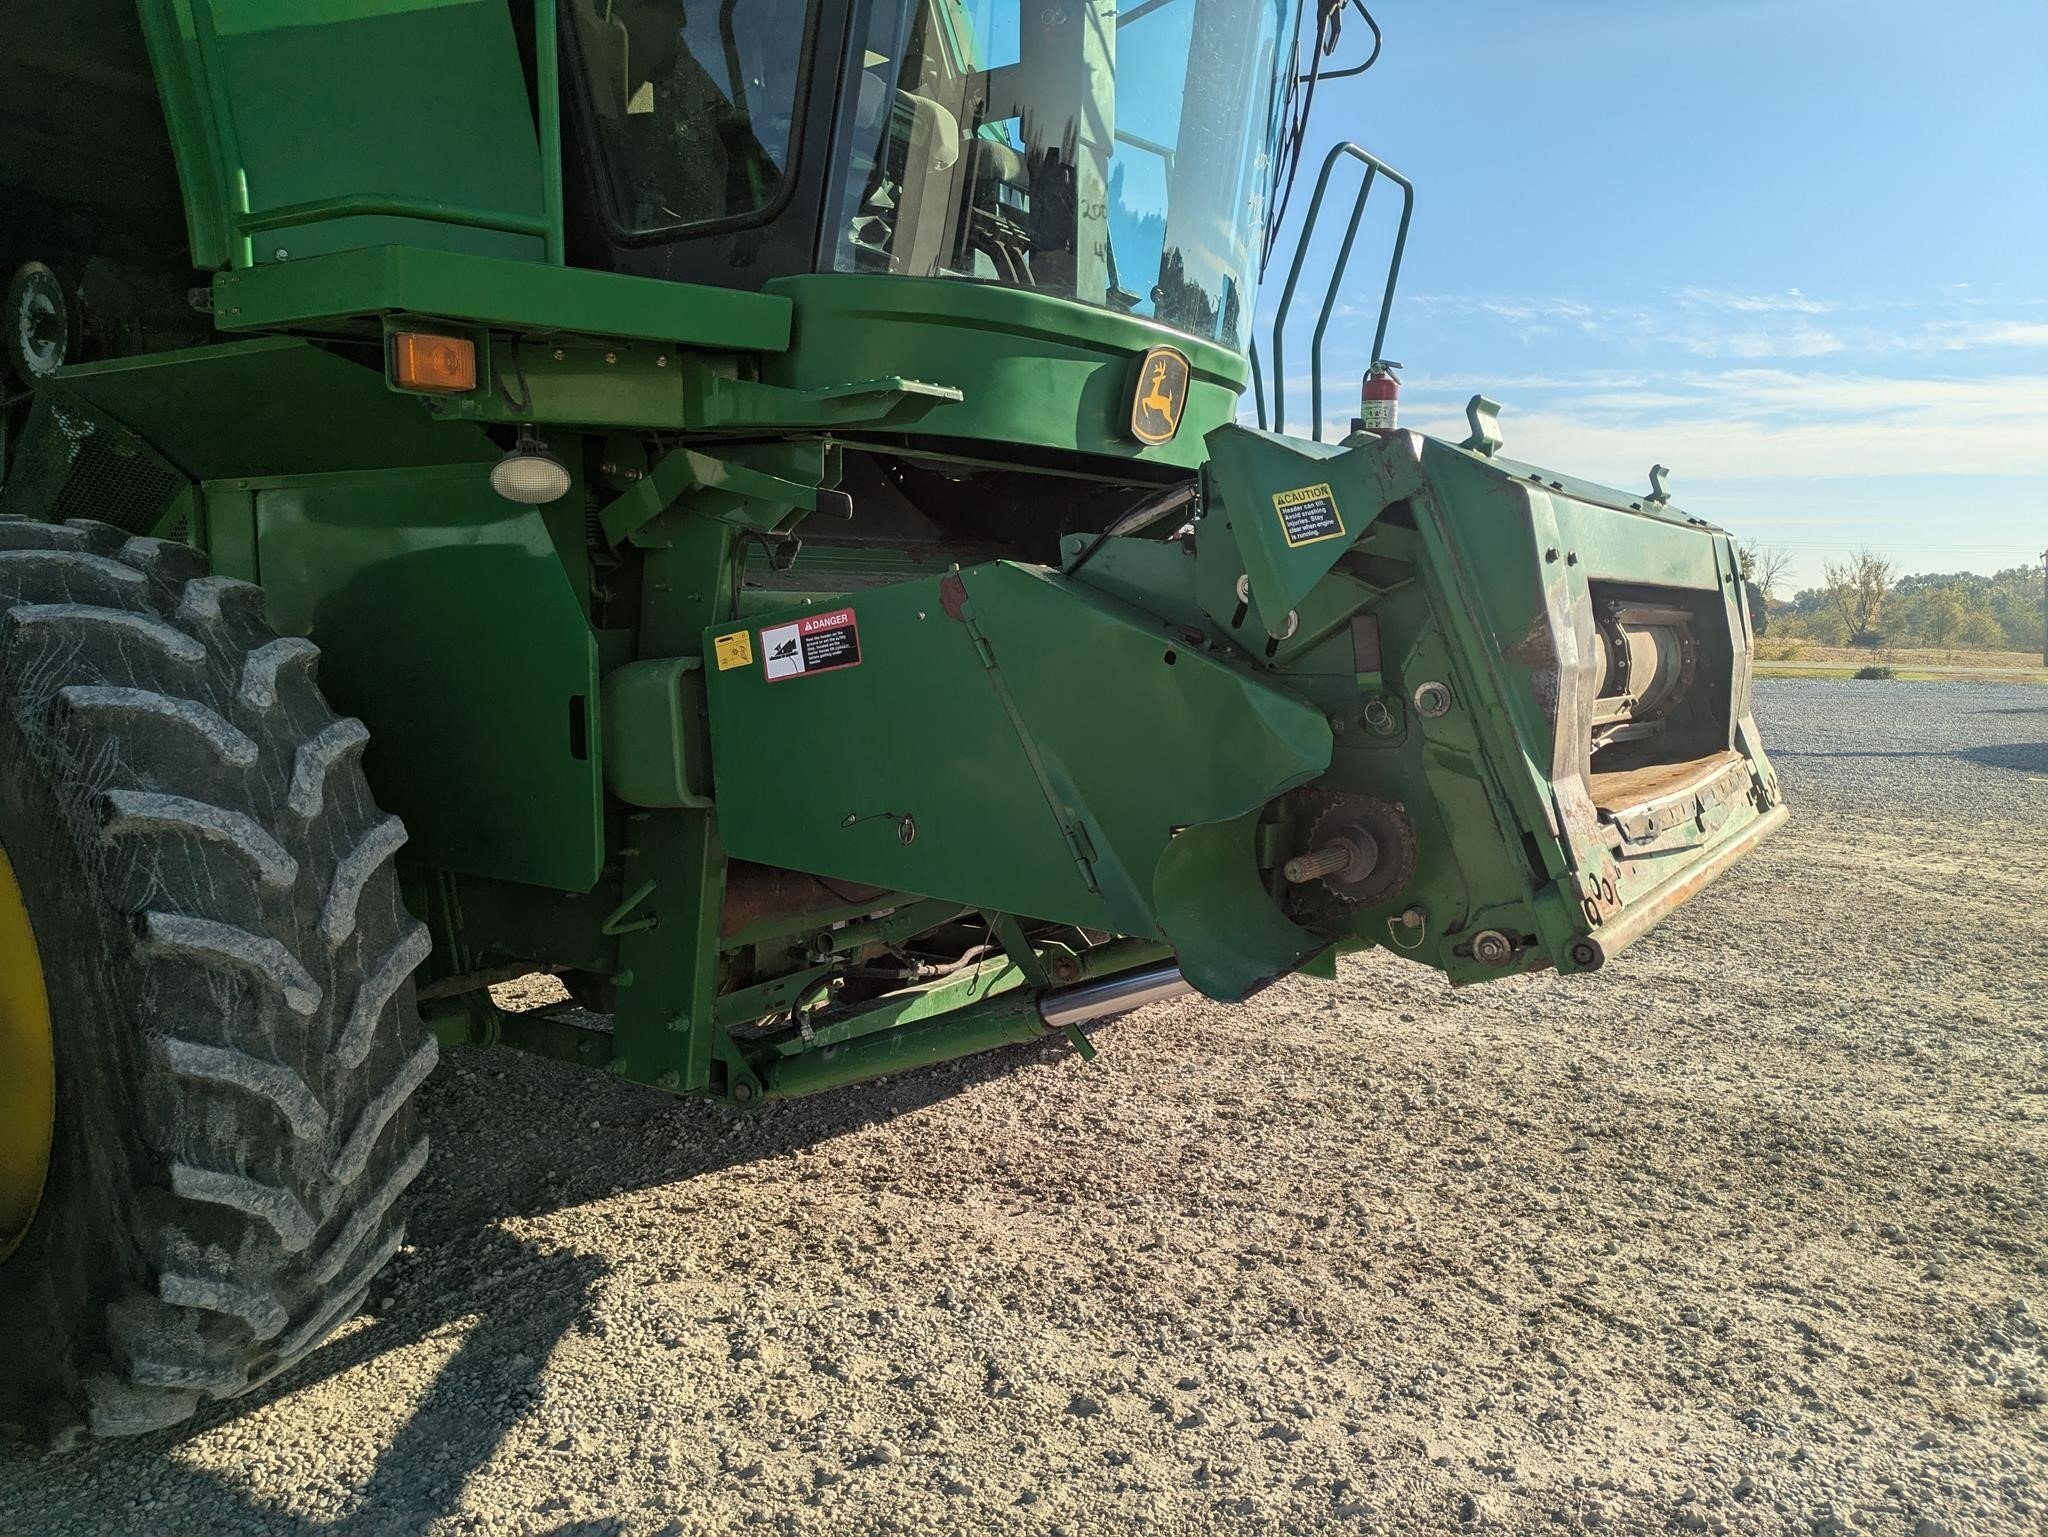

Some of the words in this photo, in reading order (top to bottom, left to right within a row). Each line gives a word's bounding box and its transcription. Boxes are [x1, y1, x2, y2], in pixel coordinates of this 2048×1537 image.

[1284, 486, 1328, 503] CAUTION
[1282, 506, 1303, 514] Header
[1285, 512, 1301, 520] Avoid
[1302, 508, 1326, 517] crushing
[813, 614, 848, 629] DANGER
